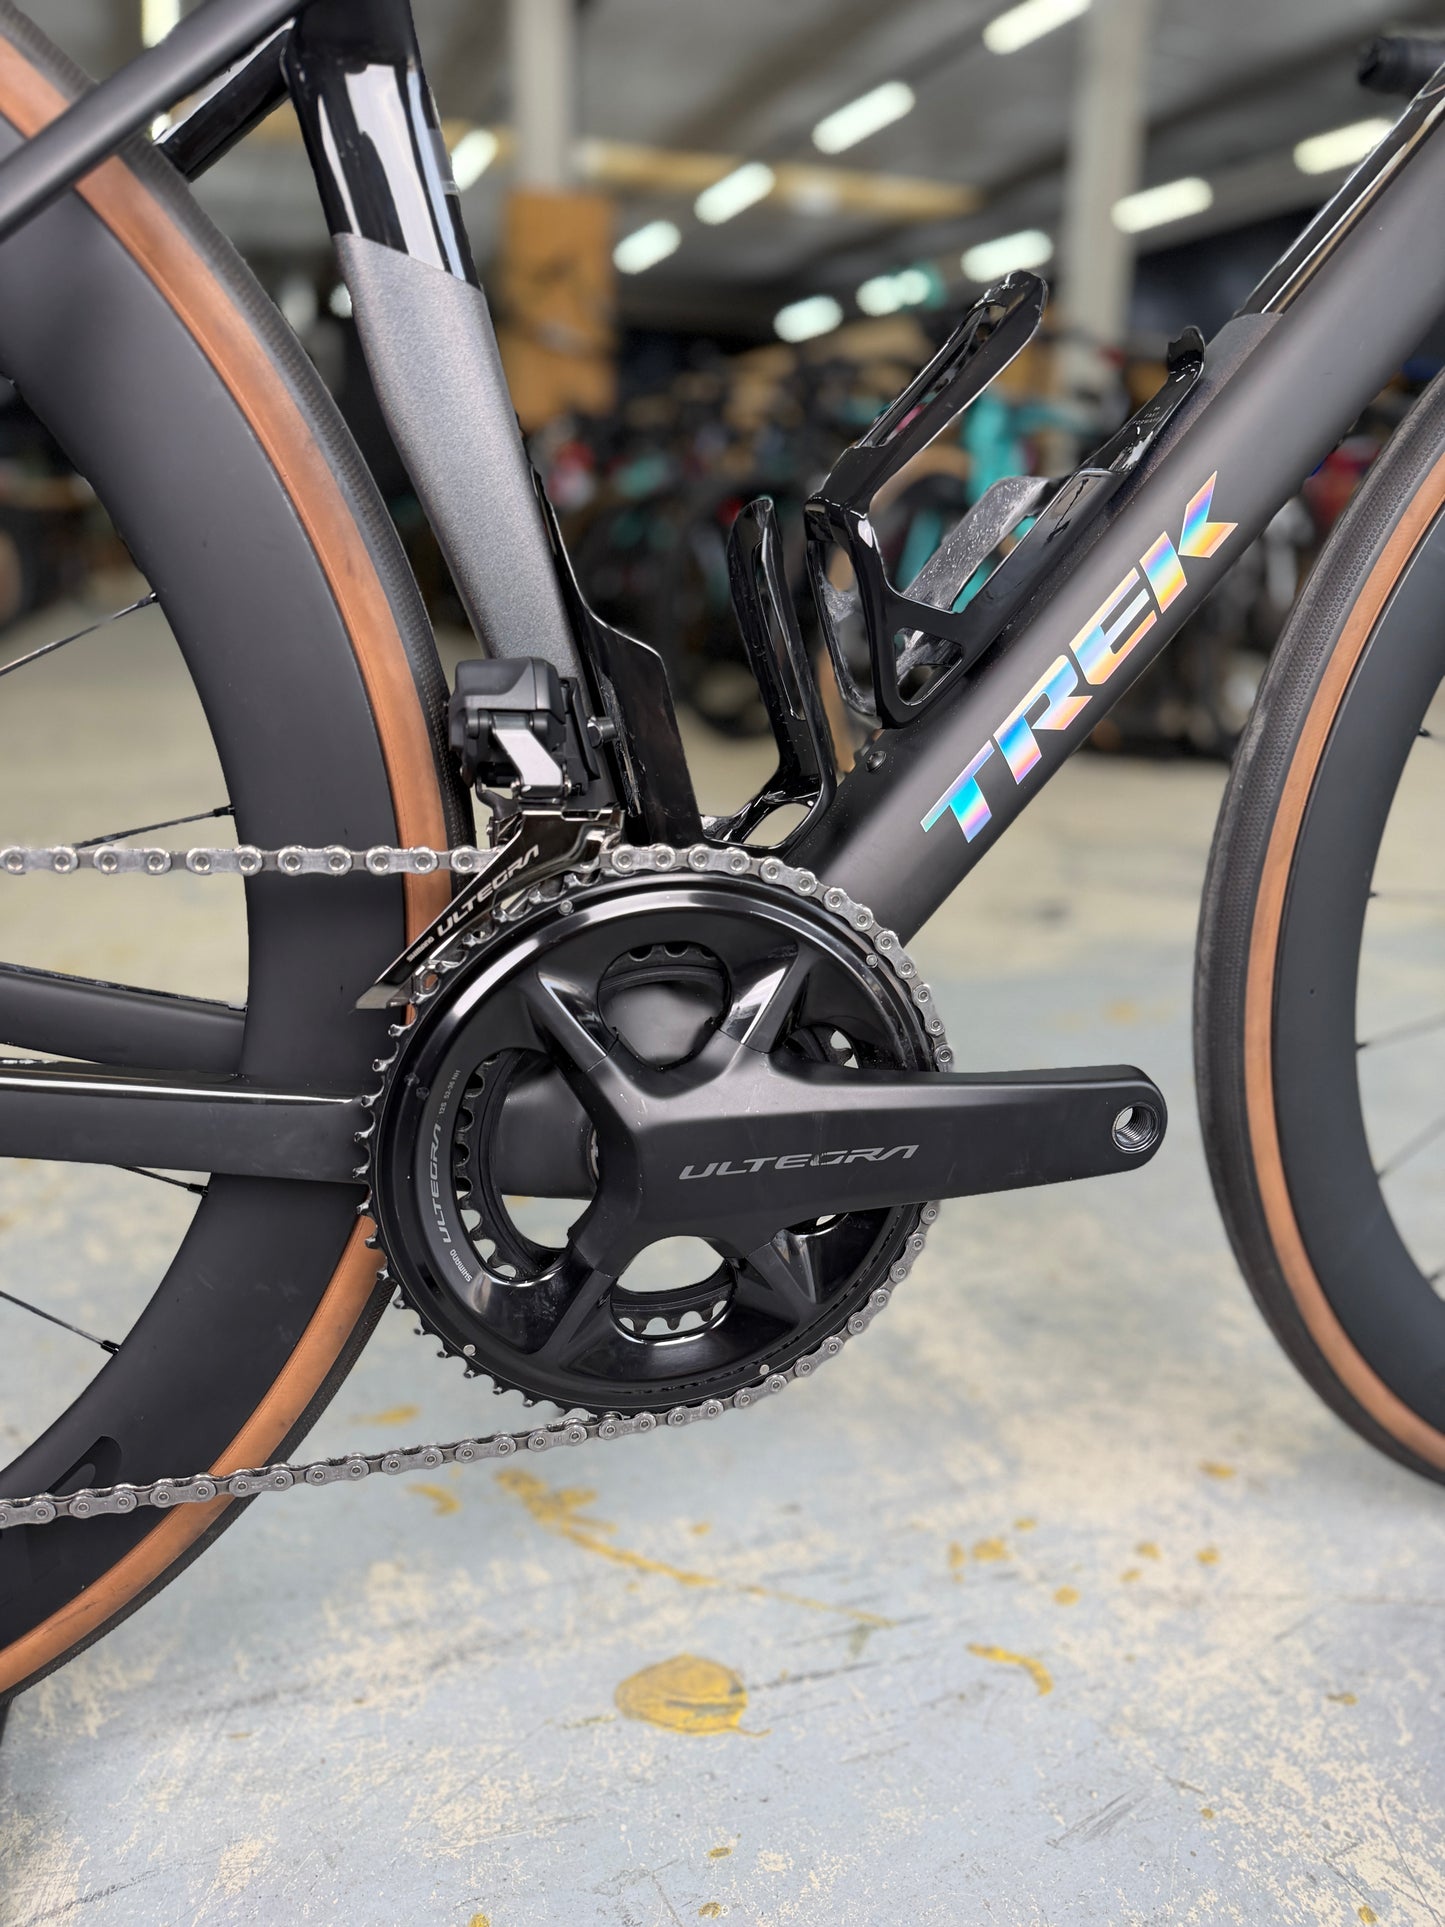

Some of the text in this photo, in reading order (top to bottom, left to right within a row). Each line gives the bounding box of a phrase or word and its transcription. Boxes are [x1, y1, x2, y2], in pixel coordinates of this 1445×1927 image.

[920, 470, 1239, 843] TREK
[437, 844, 540, 937] ULTEGRA
[430, 1123, 452, 1243] ULTEGRA
[679, 1144, 920, 1180] ULTEGRA
[450, 1249, 473, 1282] SHIMANO
